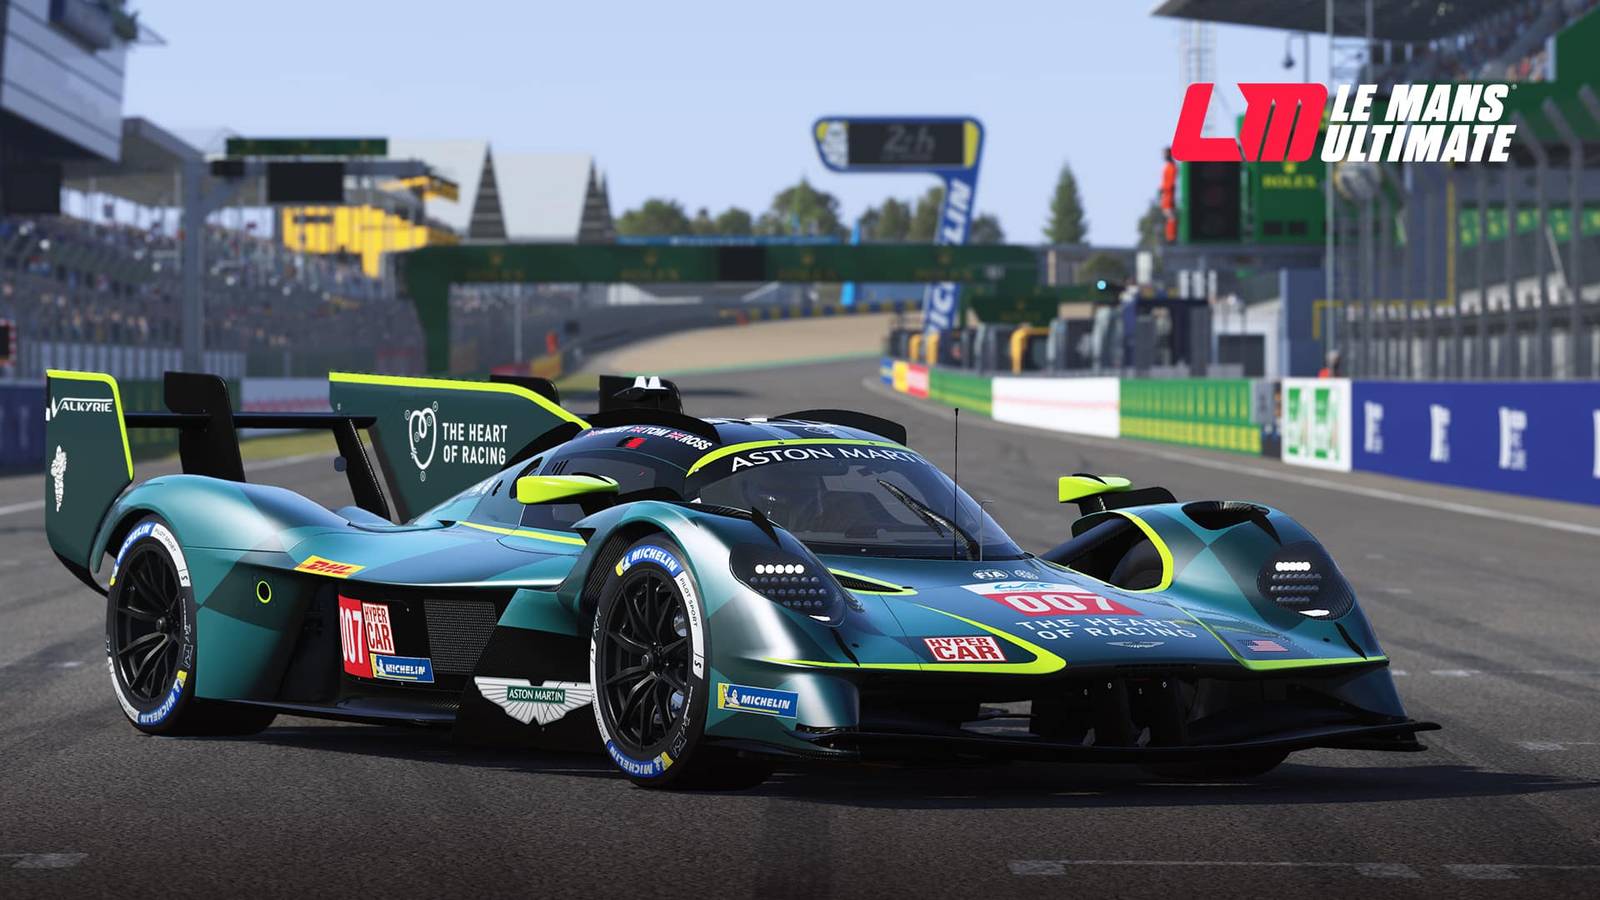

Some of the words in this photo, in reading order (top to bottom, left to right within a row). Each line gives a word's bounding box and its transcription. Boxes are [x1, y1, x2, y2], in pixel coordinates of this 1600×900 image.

[51, 396, 114, 418] VALKYRIE
[442, 422, 465, 441] THE
[469, 423, 508, 443] HEART
[642, 427, 671, 437] TOM
[680, 434, 713, 451] ROSS
[443, 445, 459, 463] OF
[462, 445, 506, 465] RACING
[731, 448, 835, 472] ASTON
[838, 448, 928, 466] MARTI
[631, 547, 678, 573] MICHELIN
[976, 570, 1005, 580] FIA
[680, 577, 691, 598] PILOT
[688, 599, 698, 627] SPORT
[1003, 594, 1115, 613] 007
[364, 606, 388, 624] HYPER
[1015, 618, 1081, 631] THE
[1085, 617, 1183, 630] HEART
[367, 622, 393, 651] CAR
[928, 637, 990, 647] HYPER
[1037, 628, 1075, 640] OF
[1091, 626, 1198, 639] RACING
[934, 645, 1000, 660] CAR
[385, 663, 426, 675] MICHELIN
[509, 689, 534, 700] ASTON
[535, 690, 564, 701] MARTIN
[741, 694, 791, 710] MICHELIN
[140, 692, 176, 723] MICHELIN
[609, 746, 653, 774] MICHELIN
